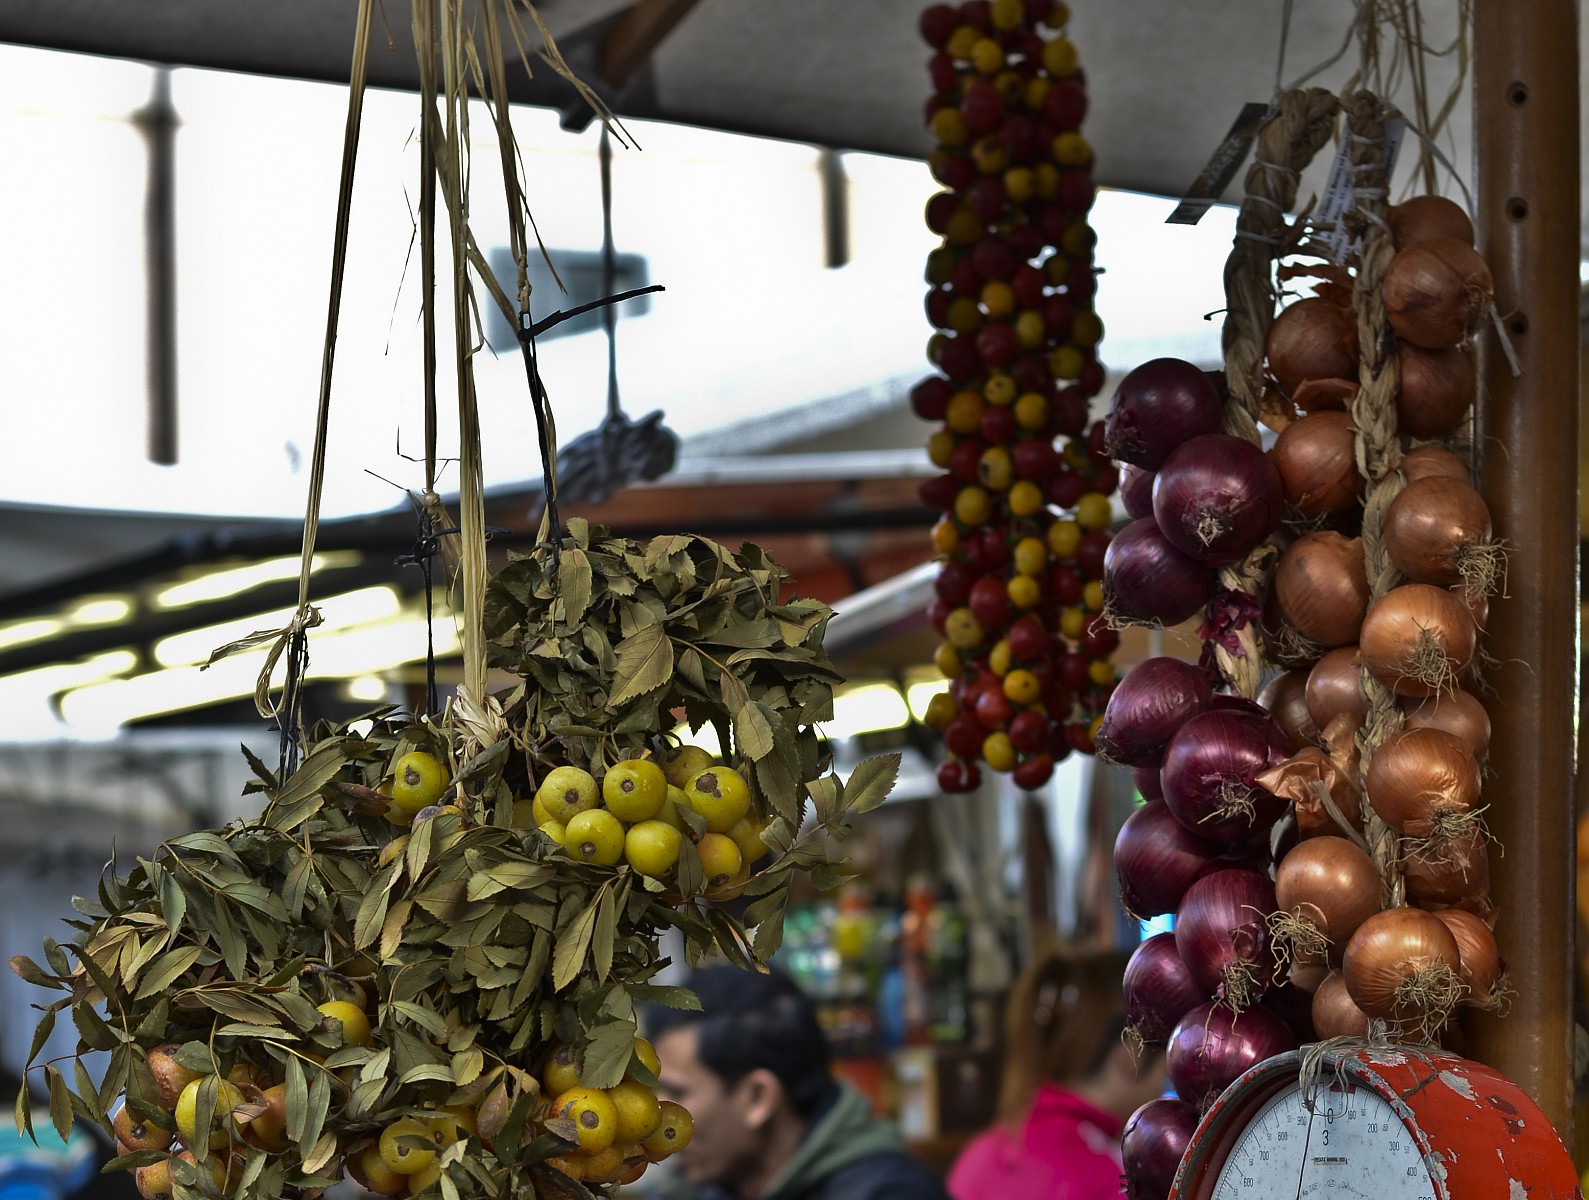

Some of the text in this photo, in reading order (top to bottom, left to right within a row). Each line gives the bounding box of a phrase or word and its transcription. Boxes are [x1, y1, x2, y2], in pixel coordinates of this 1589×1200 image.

[1368, 1123, 1378, 1133] 200
[1322, 1130, 1329, 1146] 3
[1388, 1141, 1400, 1151] 300
[1260, 1150, 1270, 1160] 700
[1406, 1167, 1418, 1177] 400
